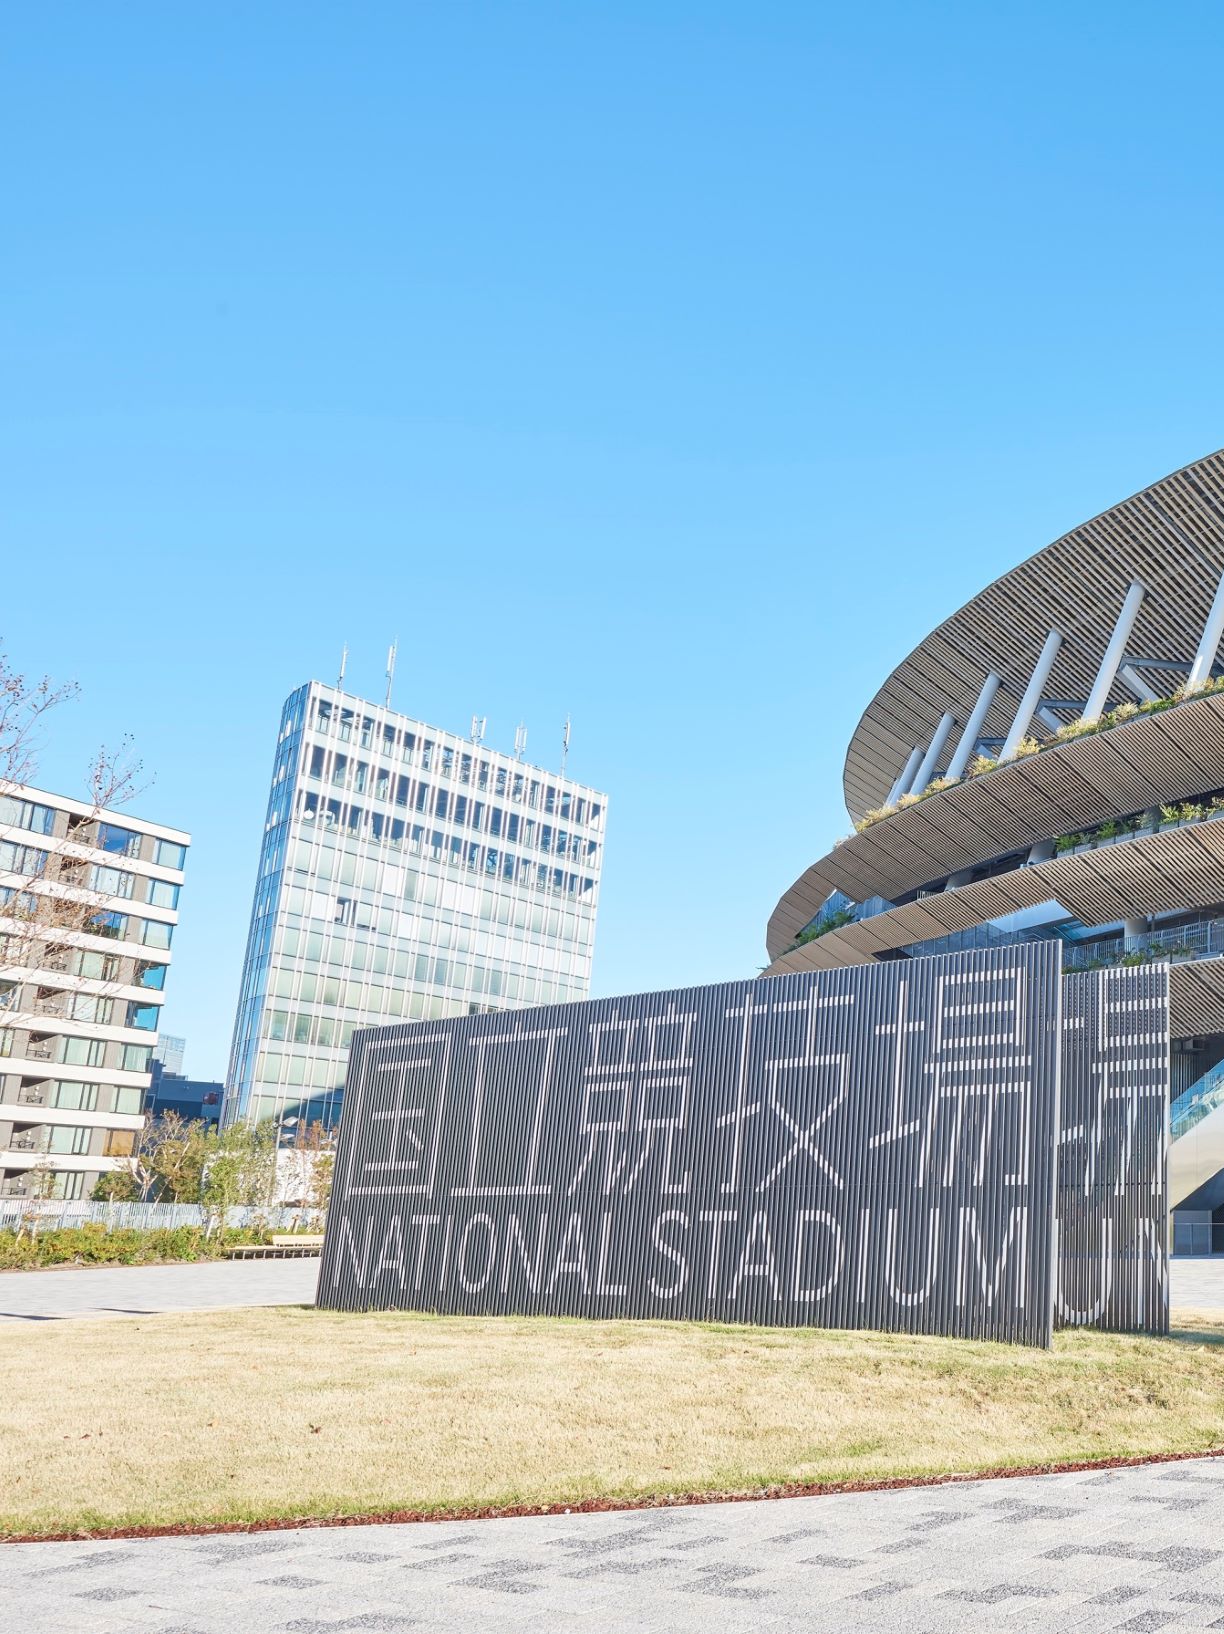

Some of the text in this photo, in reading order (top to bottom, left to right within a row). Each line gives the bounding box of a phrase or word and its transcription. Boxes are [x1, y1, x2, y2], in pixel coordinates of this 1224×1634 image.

[345, 966, 1032, 1200] 国立競技場
[332, 1211, 627, 1295] NATIONAL
[647, 1206, 1028, 1308] STADIUM
